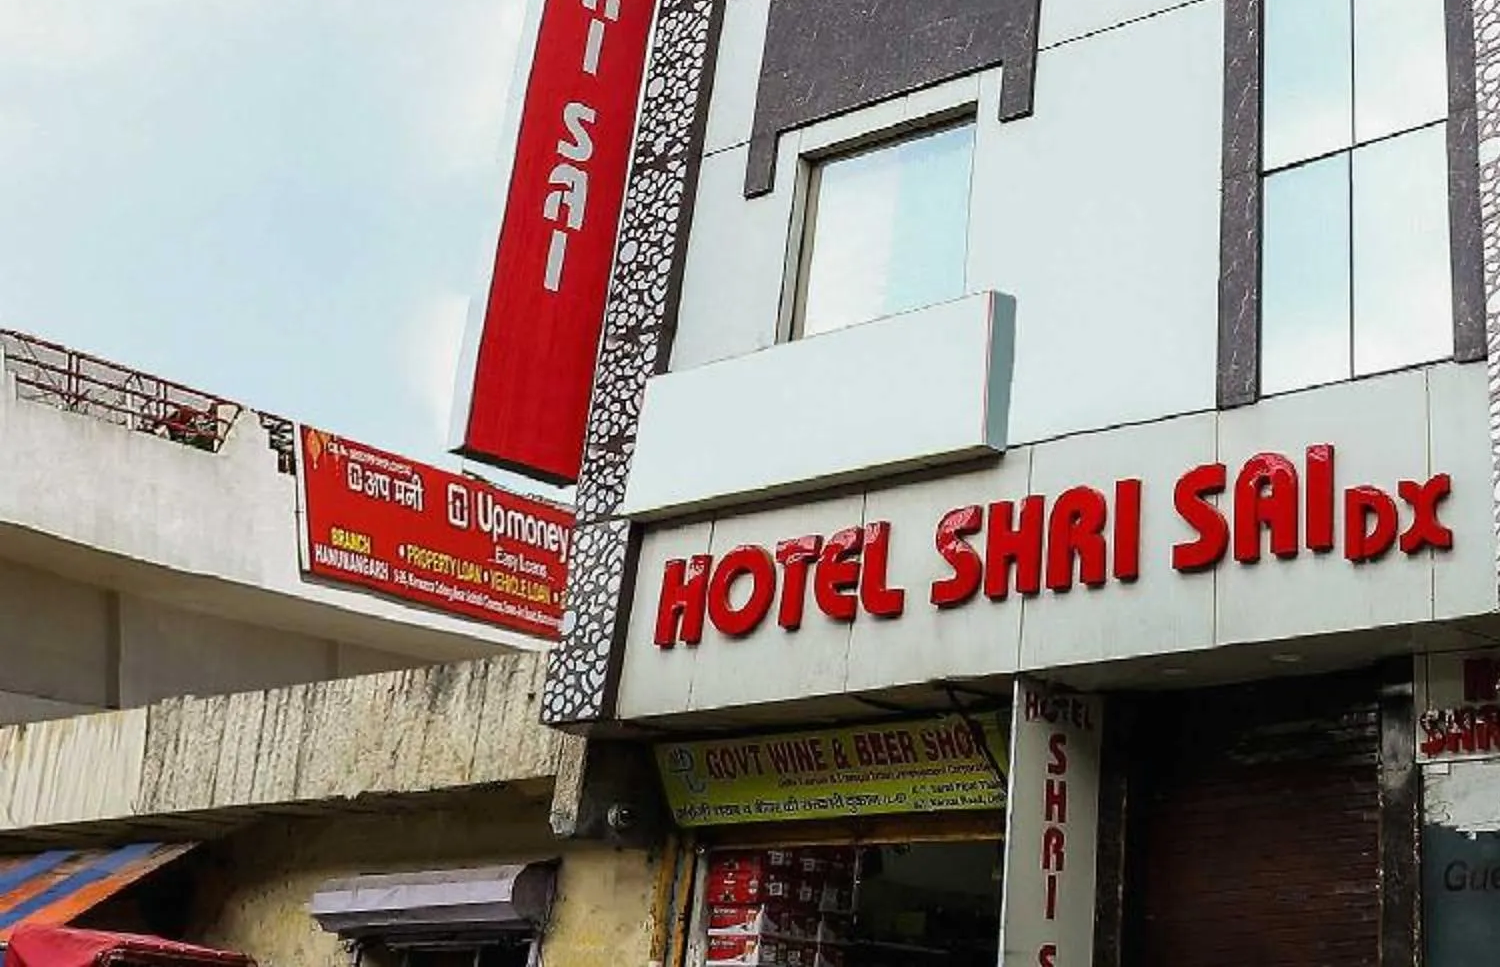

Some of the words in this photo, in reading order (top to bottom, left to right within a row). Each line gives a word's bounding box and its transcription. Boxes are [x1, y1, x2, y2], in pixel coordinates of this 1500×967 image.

[543, 103, 597, 294] SAI
[477, 491, 569, 564] Upmoney
[653, 521, 905, 649] HOTEL
[930, 478, 1142, 609] SHRI
[1172, 443, 1335, 571] SAI
[1344, 472, 1453, 564] DX
[705, 744, 764, 780] GOVT
[767, 738, 828, 774] WINE
[830, 739, 850, 770] &
[855, 729, 917, 767] BEER
[1041, 733, 1068, 920] SHRI
